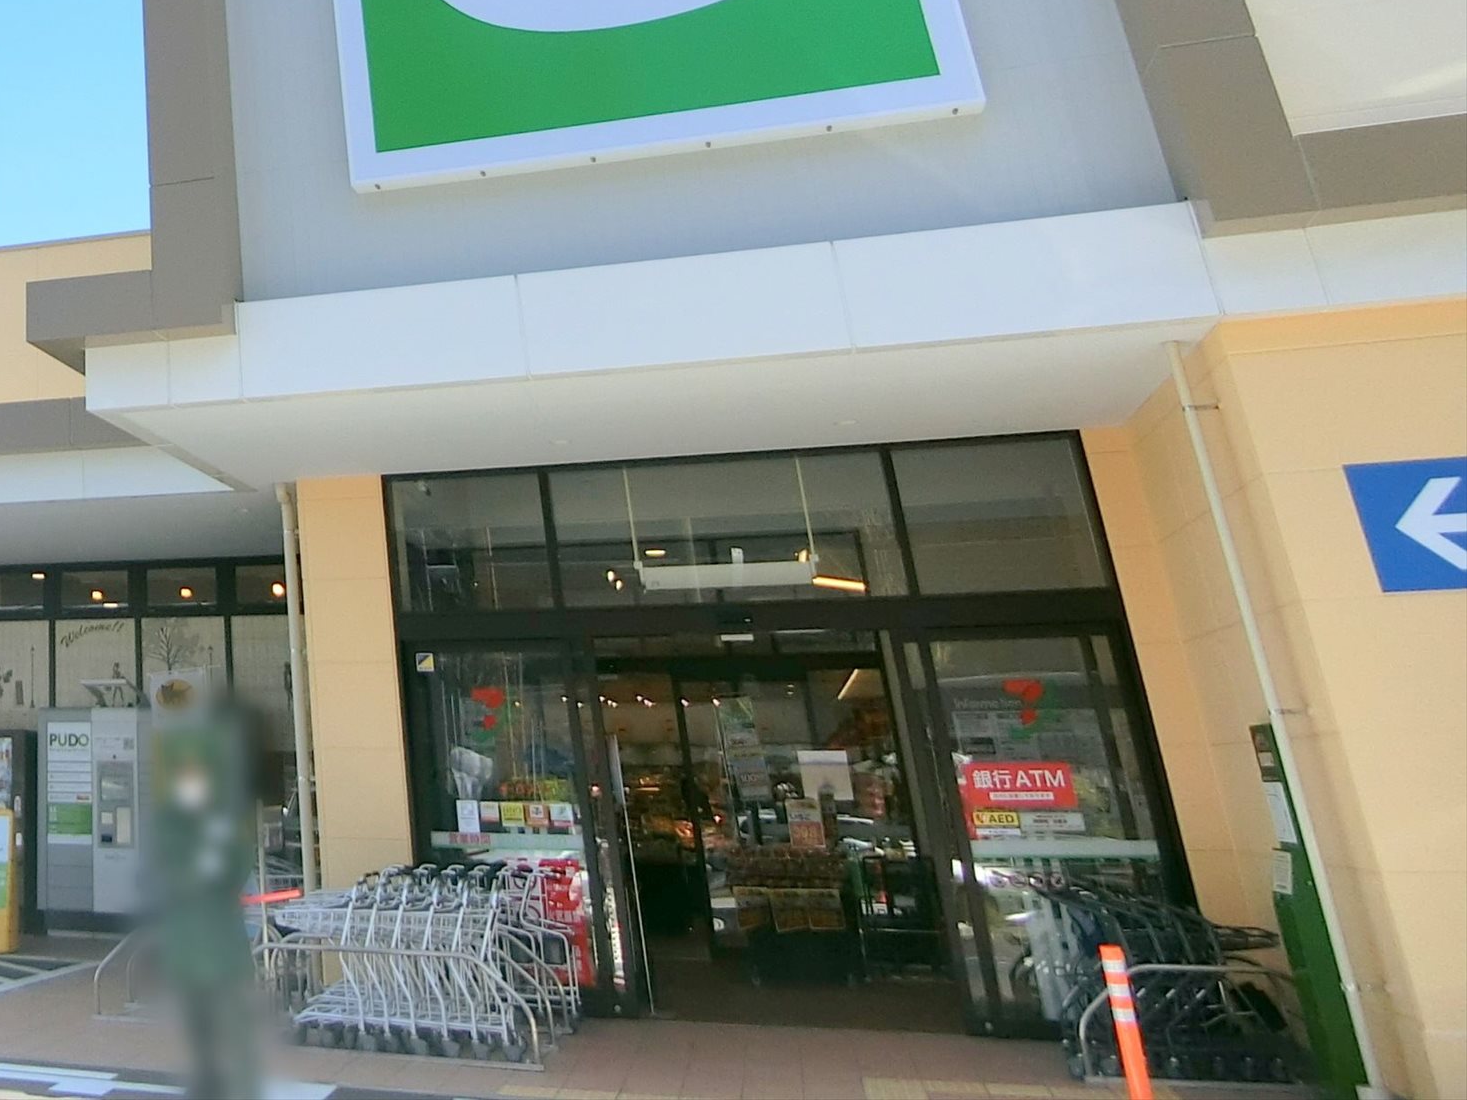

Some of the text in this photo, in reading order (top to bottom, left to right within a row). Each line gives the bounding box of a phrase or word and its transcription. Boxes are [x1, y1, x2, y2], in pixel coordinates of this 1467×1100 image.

[60, 620, 125, 648] Welcome!!
[49, 733, 90, 747] PUDO
[989, 814, 1014, 824] AED
